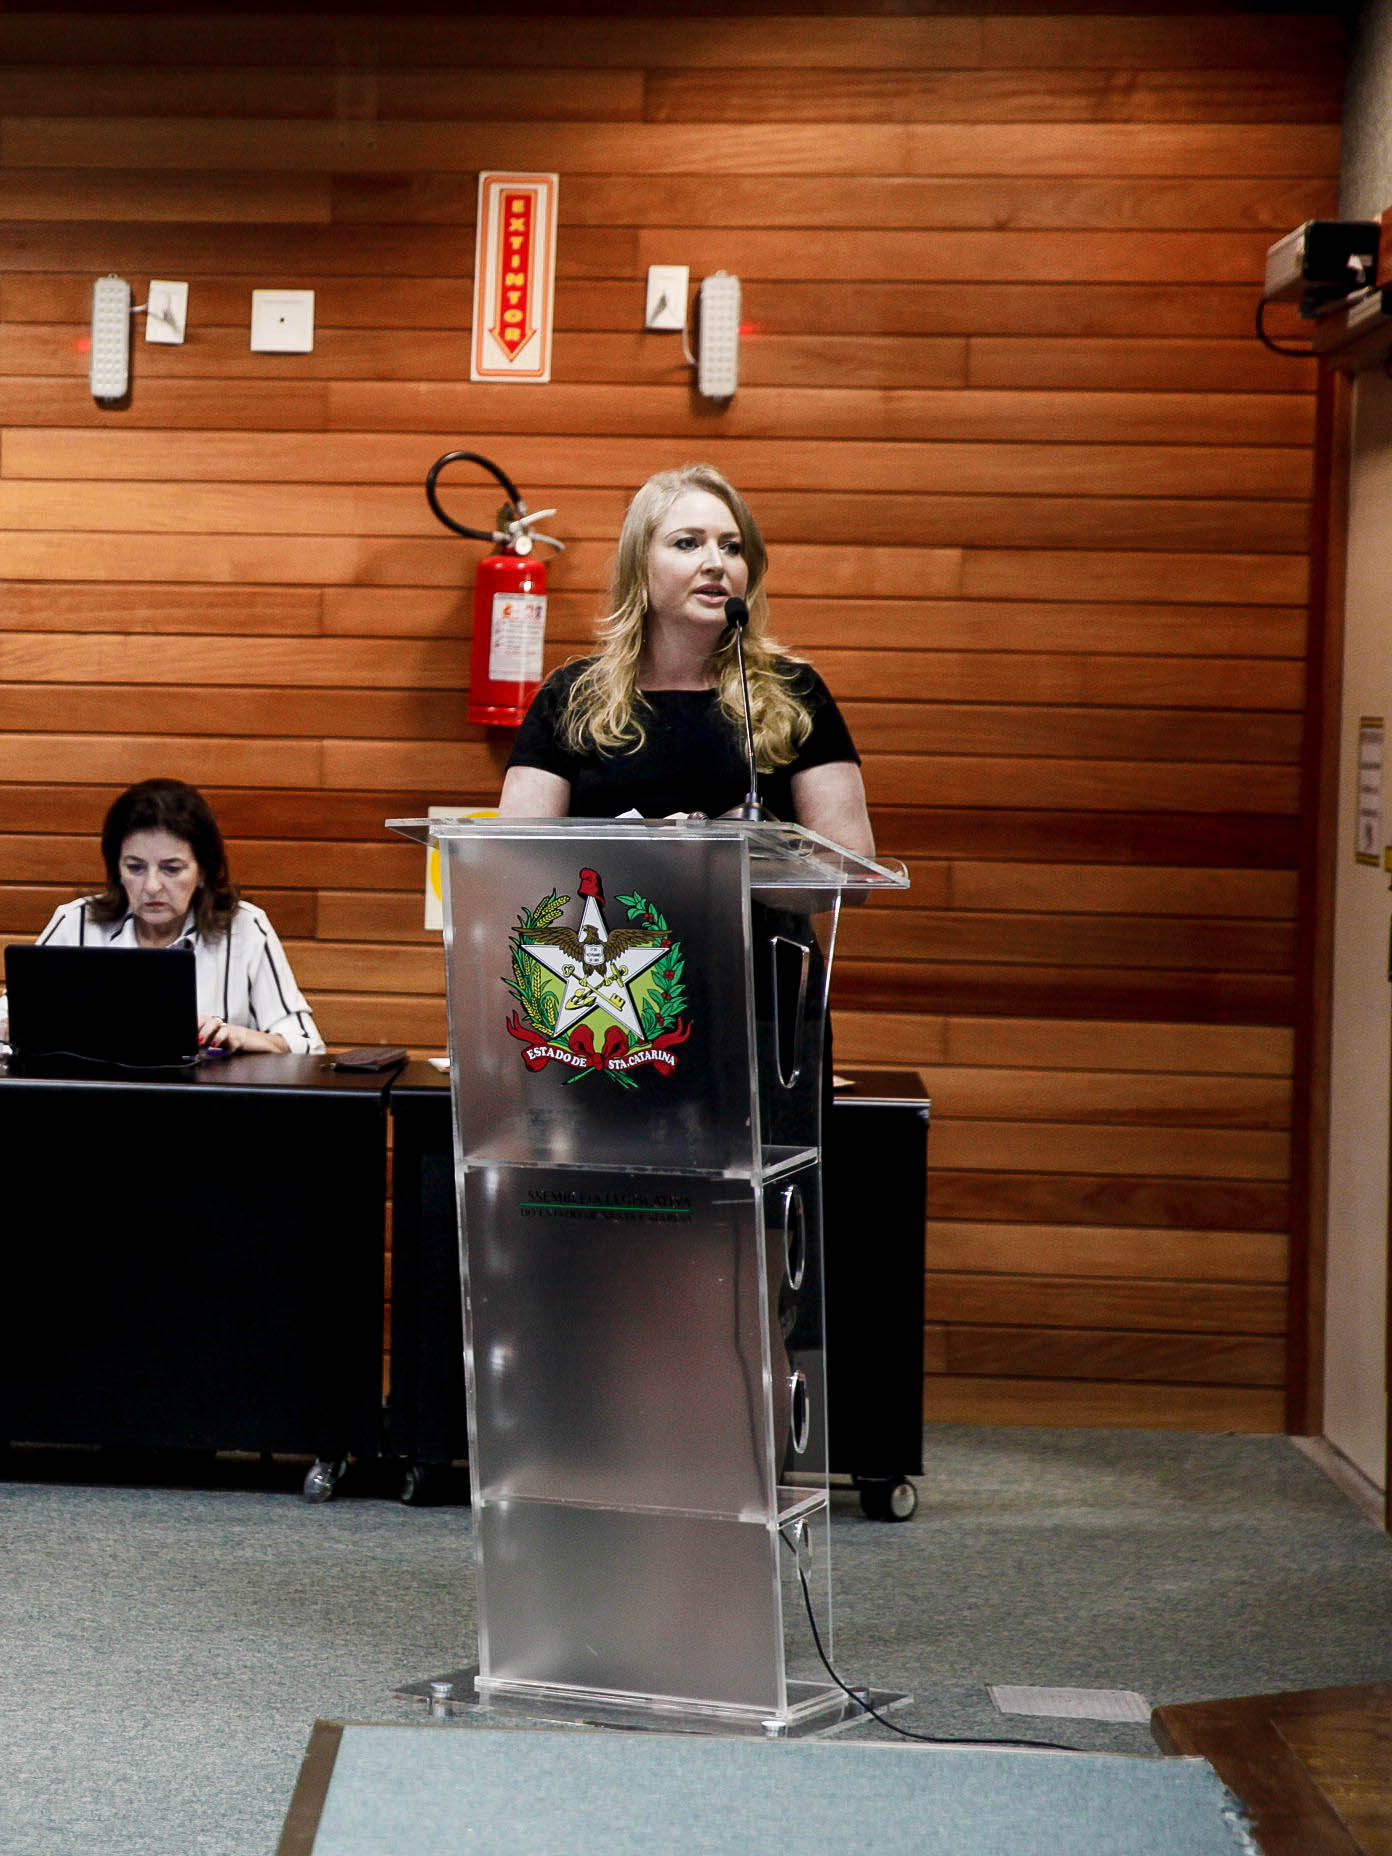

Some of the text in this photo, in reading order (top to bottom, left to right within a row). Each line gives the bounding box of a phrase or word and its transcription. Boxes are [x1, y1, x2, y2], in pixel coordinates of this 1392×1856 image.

[504, 199, 527, 341] EXTINTOR
[526, 1046, 572, 1063] ESTADO
[571, 1056, 587, 1068] DE
